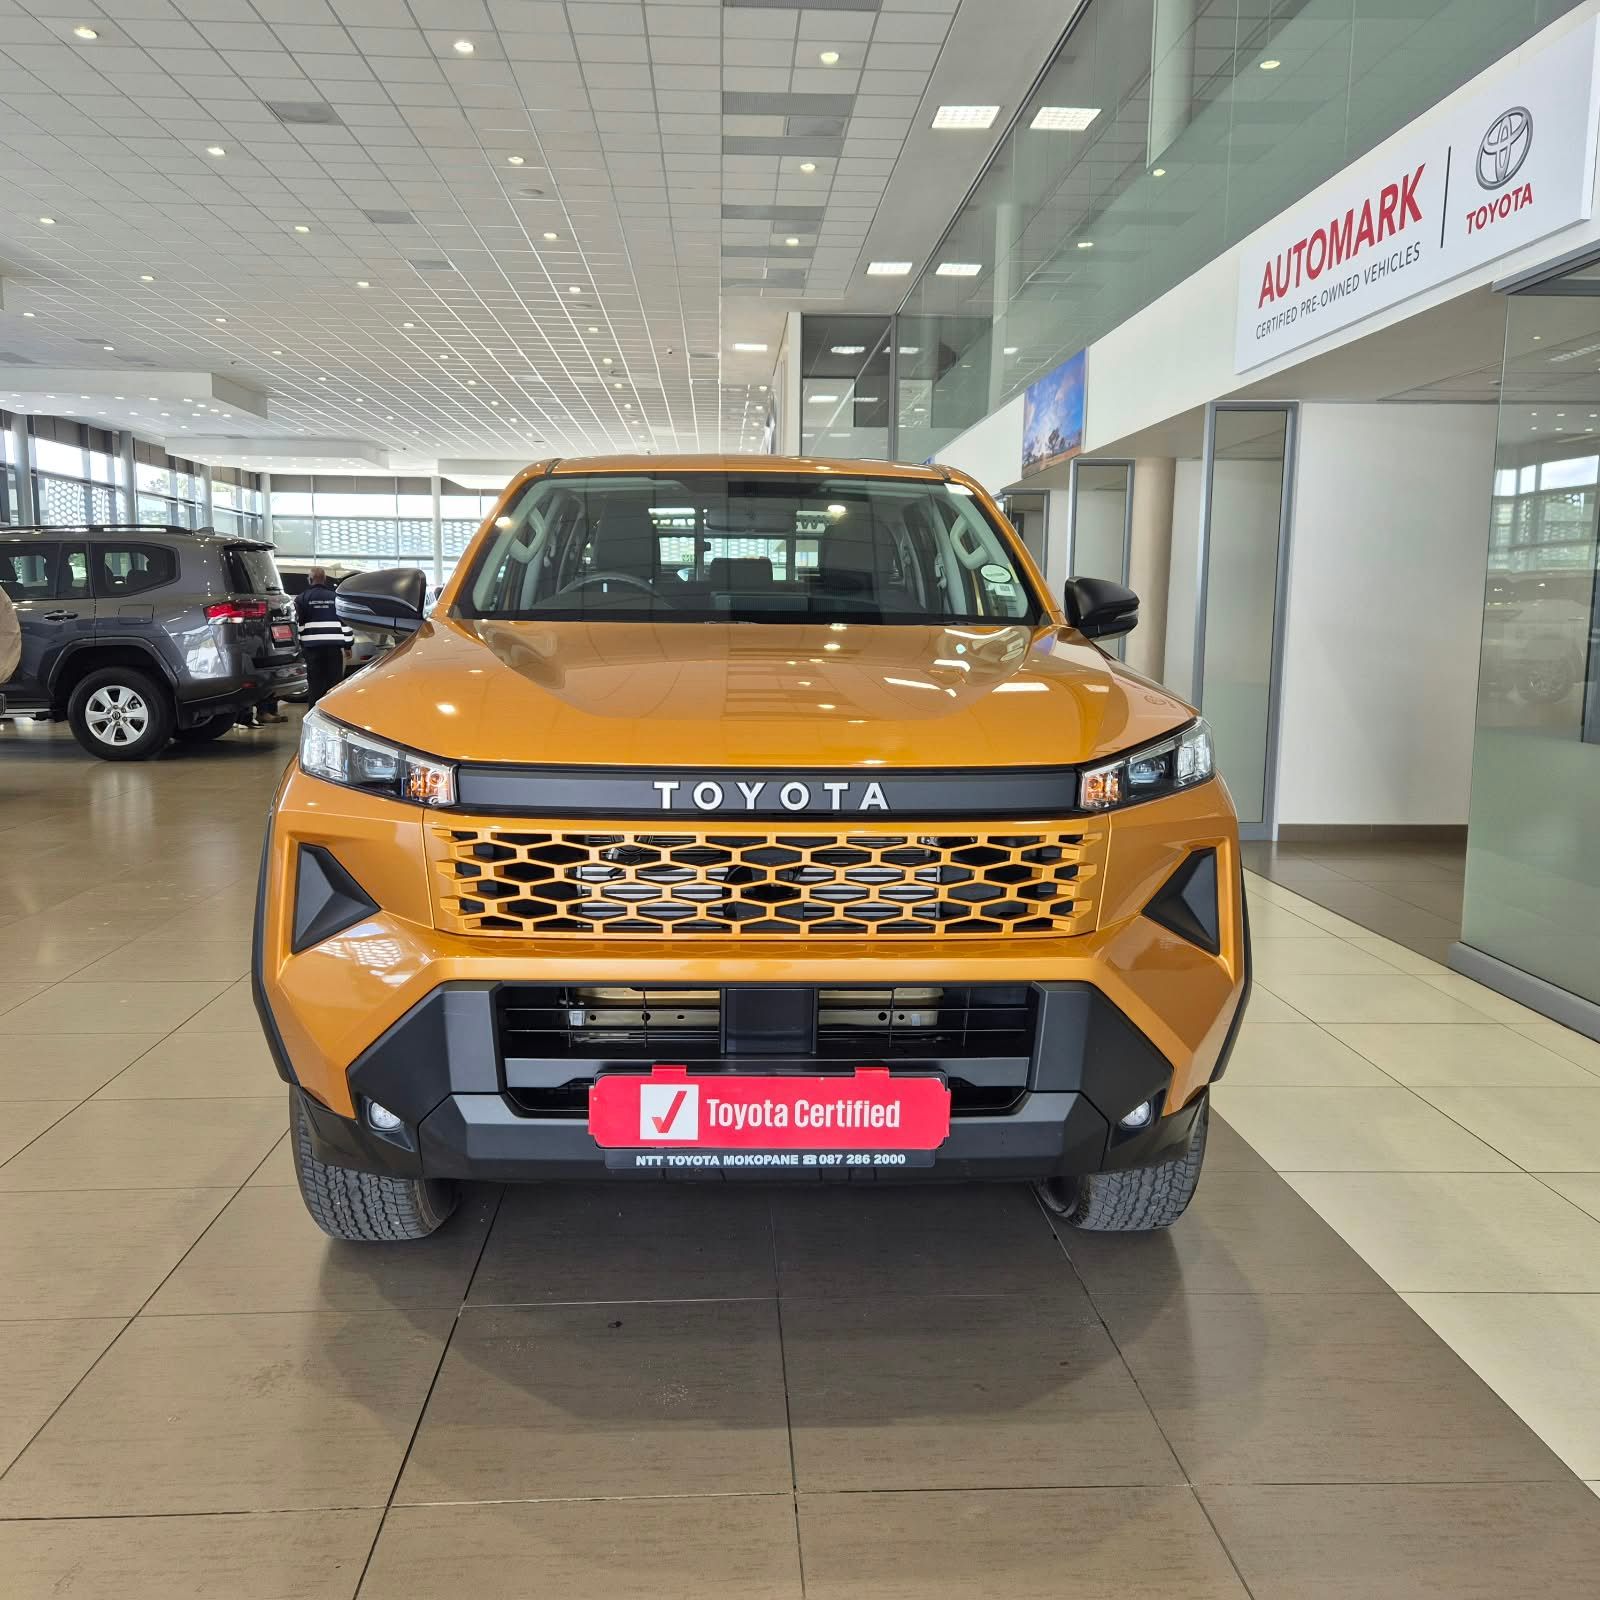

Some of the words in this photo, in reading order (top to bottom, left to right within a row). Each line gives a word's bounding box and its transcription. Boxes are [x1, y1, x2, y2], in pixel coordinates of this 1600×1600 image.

[1466, 183, 1533, 234] TOYOTA
[1258, 163, 1426, 308] AUTOMARK
[1255, 306, 1297, 340] CERTIFIED
[1300, 274, 1360, 318] PRE-OWNED
[1364, 241, 1421, 285] VEHICLES
[653, 782, 890, 811] TOYOTA
[707, 1099, 788, 1130] Toyota
[794, 1100, 900, 1128] Certified
[635, 1155, 664, 1167] NTT
[667, 1155, 720, 1167] TOYOTA
[723, 1155, 799, 1166] MOKOPANE
[819, 1154, 843, 1166] 087
[846, 1154, 871, 1166] 286
[874, 1154, 906, 1166] 2000
